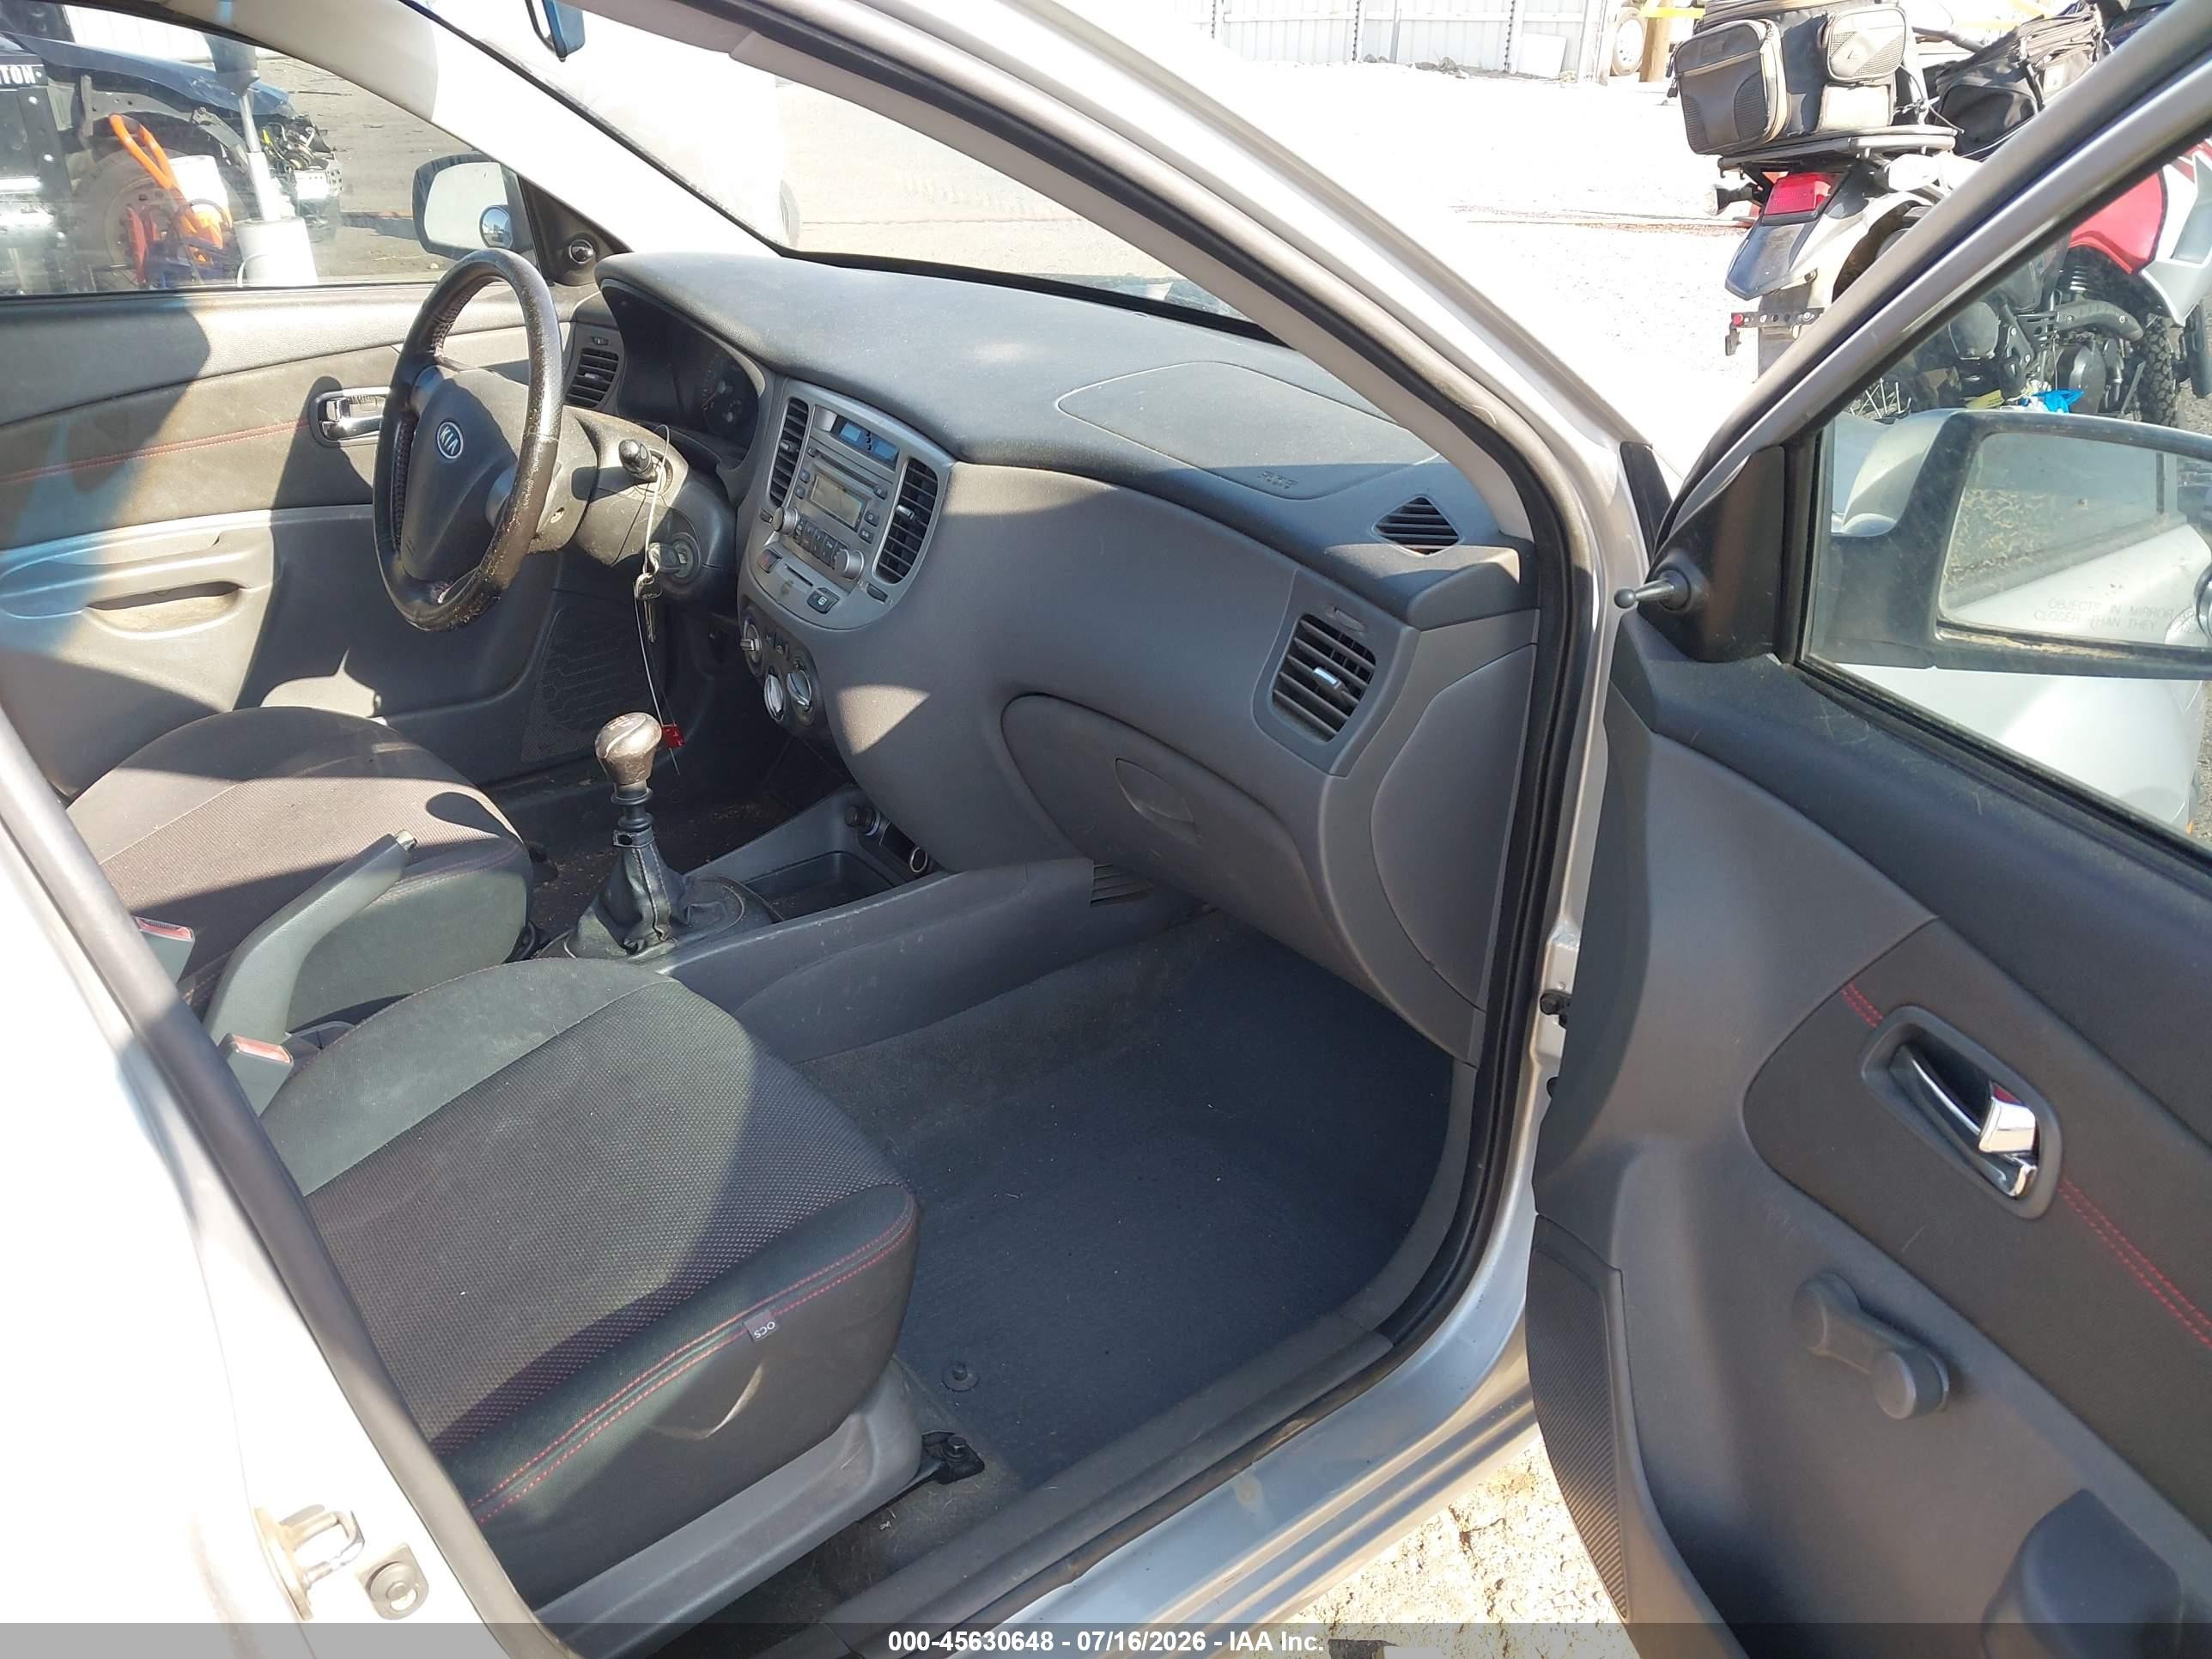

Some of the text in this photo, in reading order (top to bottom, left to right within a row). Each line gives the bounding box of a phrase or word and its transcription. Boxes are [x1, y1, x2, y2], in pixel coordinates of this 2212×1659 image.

[0, 65, 36, 84] TON
[440, 426, 459, 455] KIA
[2048, 598, 2101, 613] OBJECTS
[2110, 605, 2122, 614] IN
[2130, 605, 2174, 619] MIRROR
[2033, 610, 2157, 631] CLOSER THAN THEY
[754, 1321, 775, 1339] OCS
